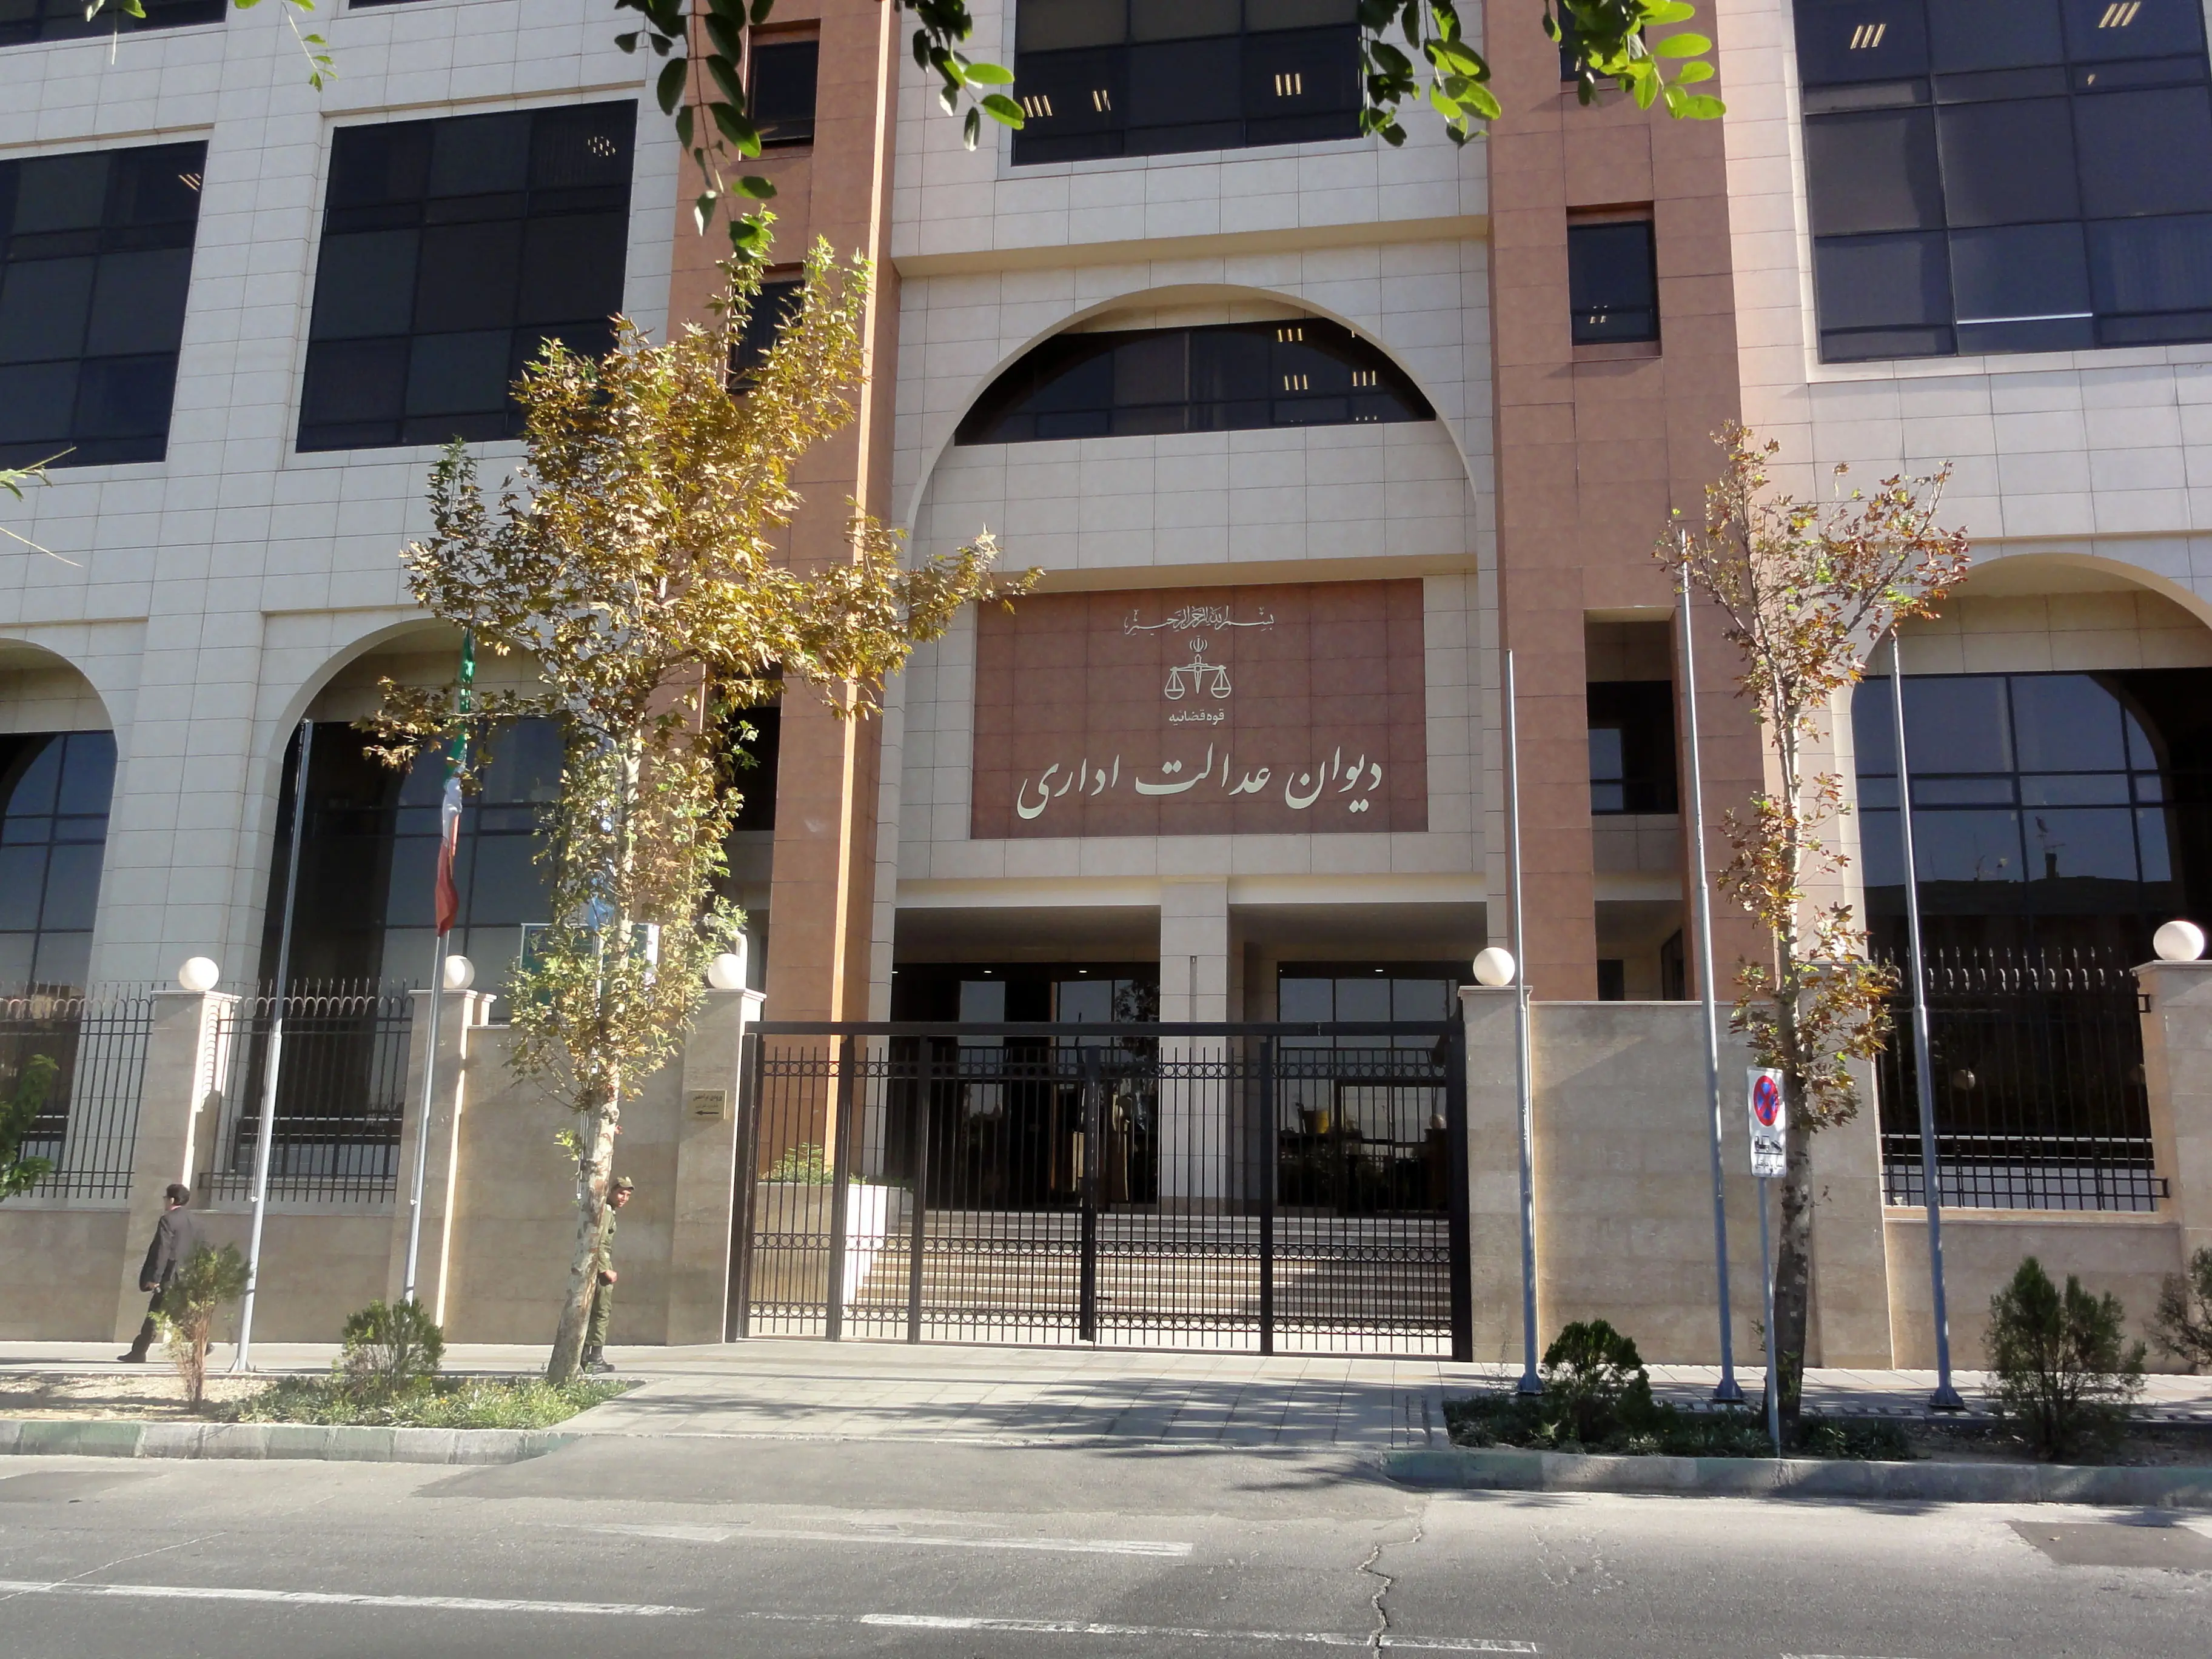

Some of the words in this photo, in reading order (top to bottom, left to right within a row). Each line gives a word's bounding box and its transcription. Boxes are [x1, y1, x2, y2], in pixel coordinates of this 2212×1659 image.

[1207, 708, 1225, 726] قوه
[1016, 754, 1120, 820] اداری
[1135, 742, 1272, 796] عدالت
[1285, 746, 1382, 813] دیوان
